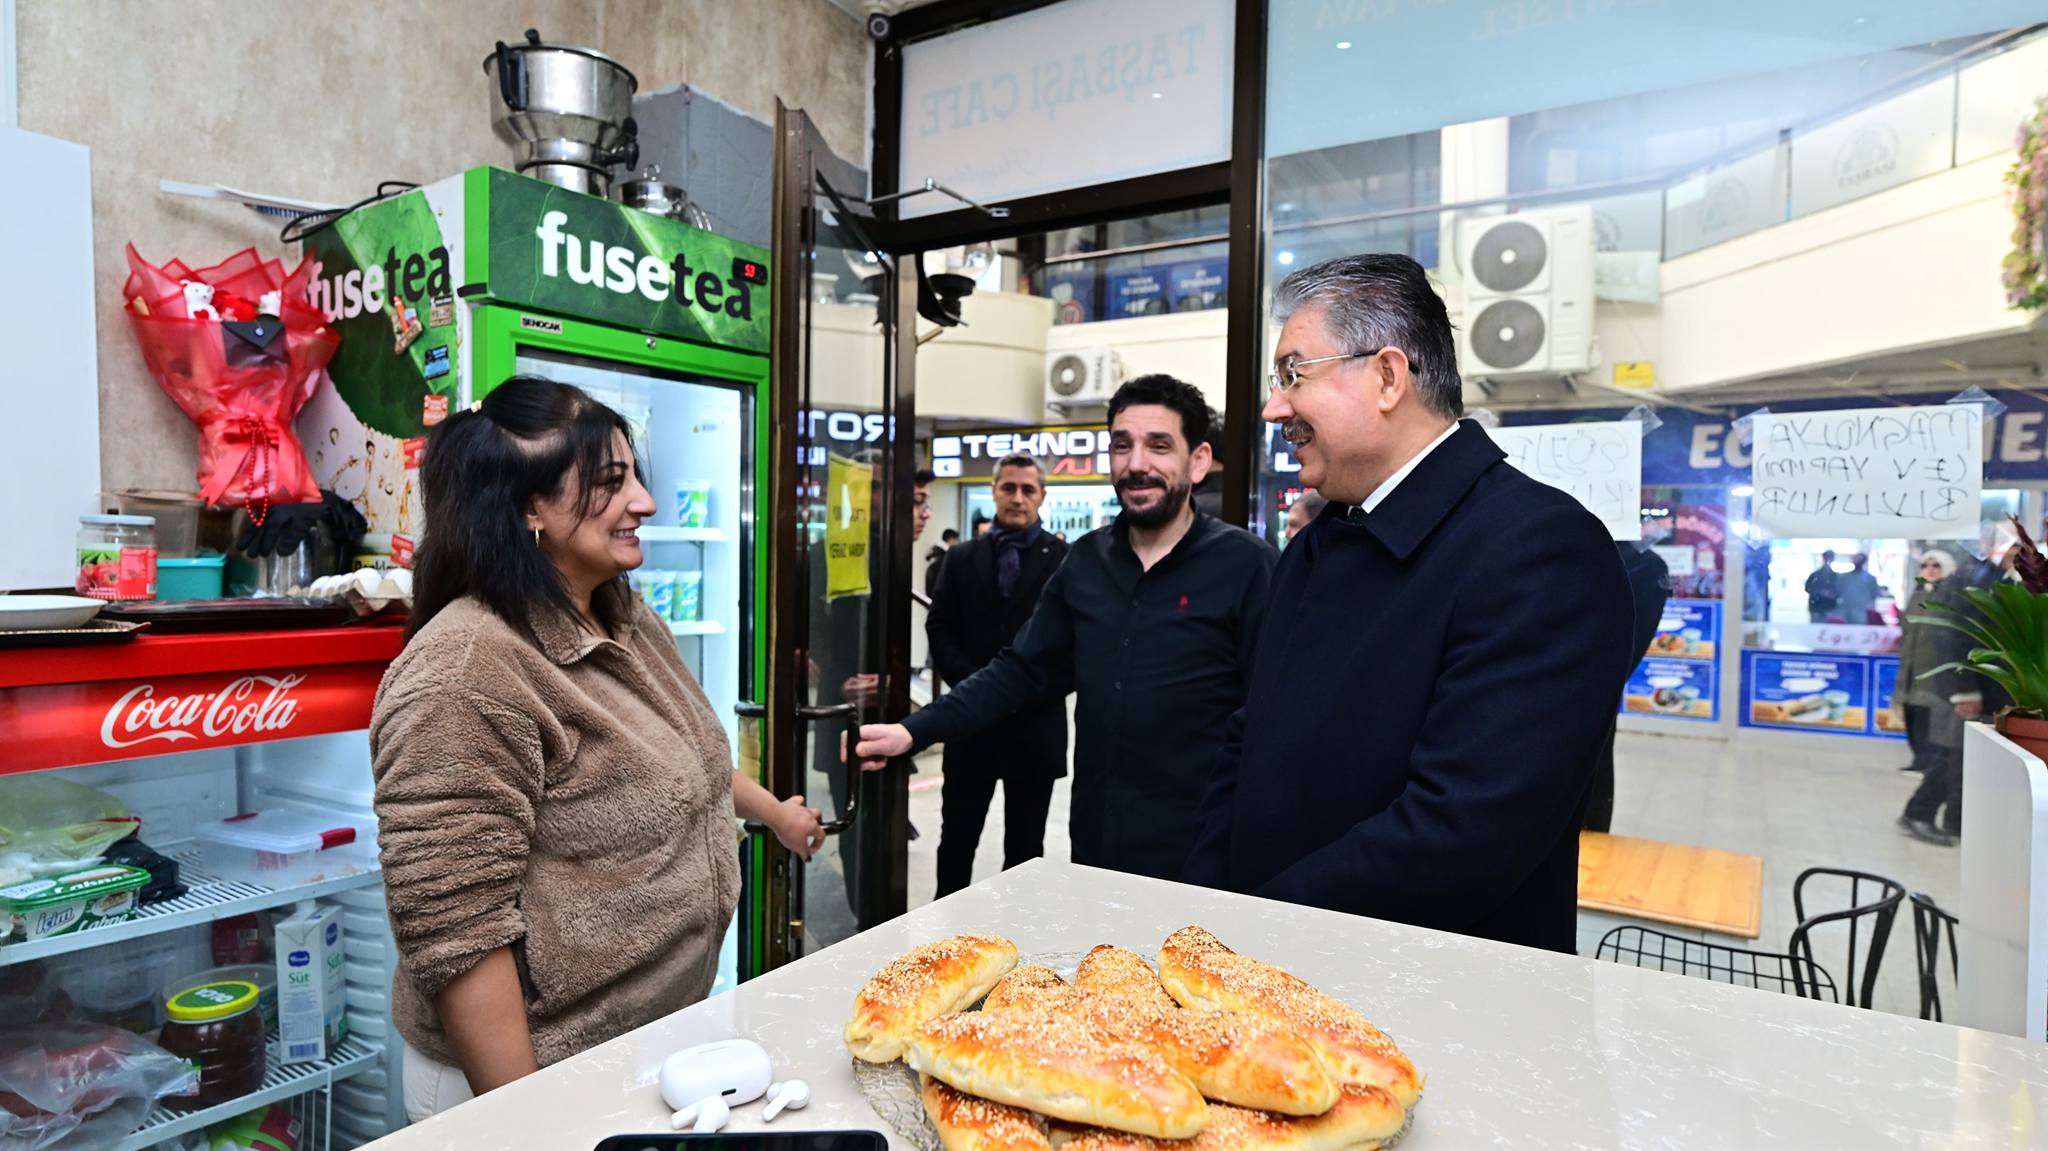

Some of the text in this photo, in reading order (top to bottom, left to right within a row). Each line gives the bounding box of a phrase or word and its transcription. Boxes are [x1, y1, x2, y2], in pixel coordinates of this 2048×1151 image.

[307, 246, 450, 324] fusetea
[536, 210, 752, 321] fusetea
[99, 673, 307, 749] Coca-Cola
[288, 972, 311, 985] Süt
